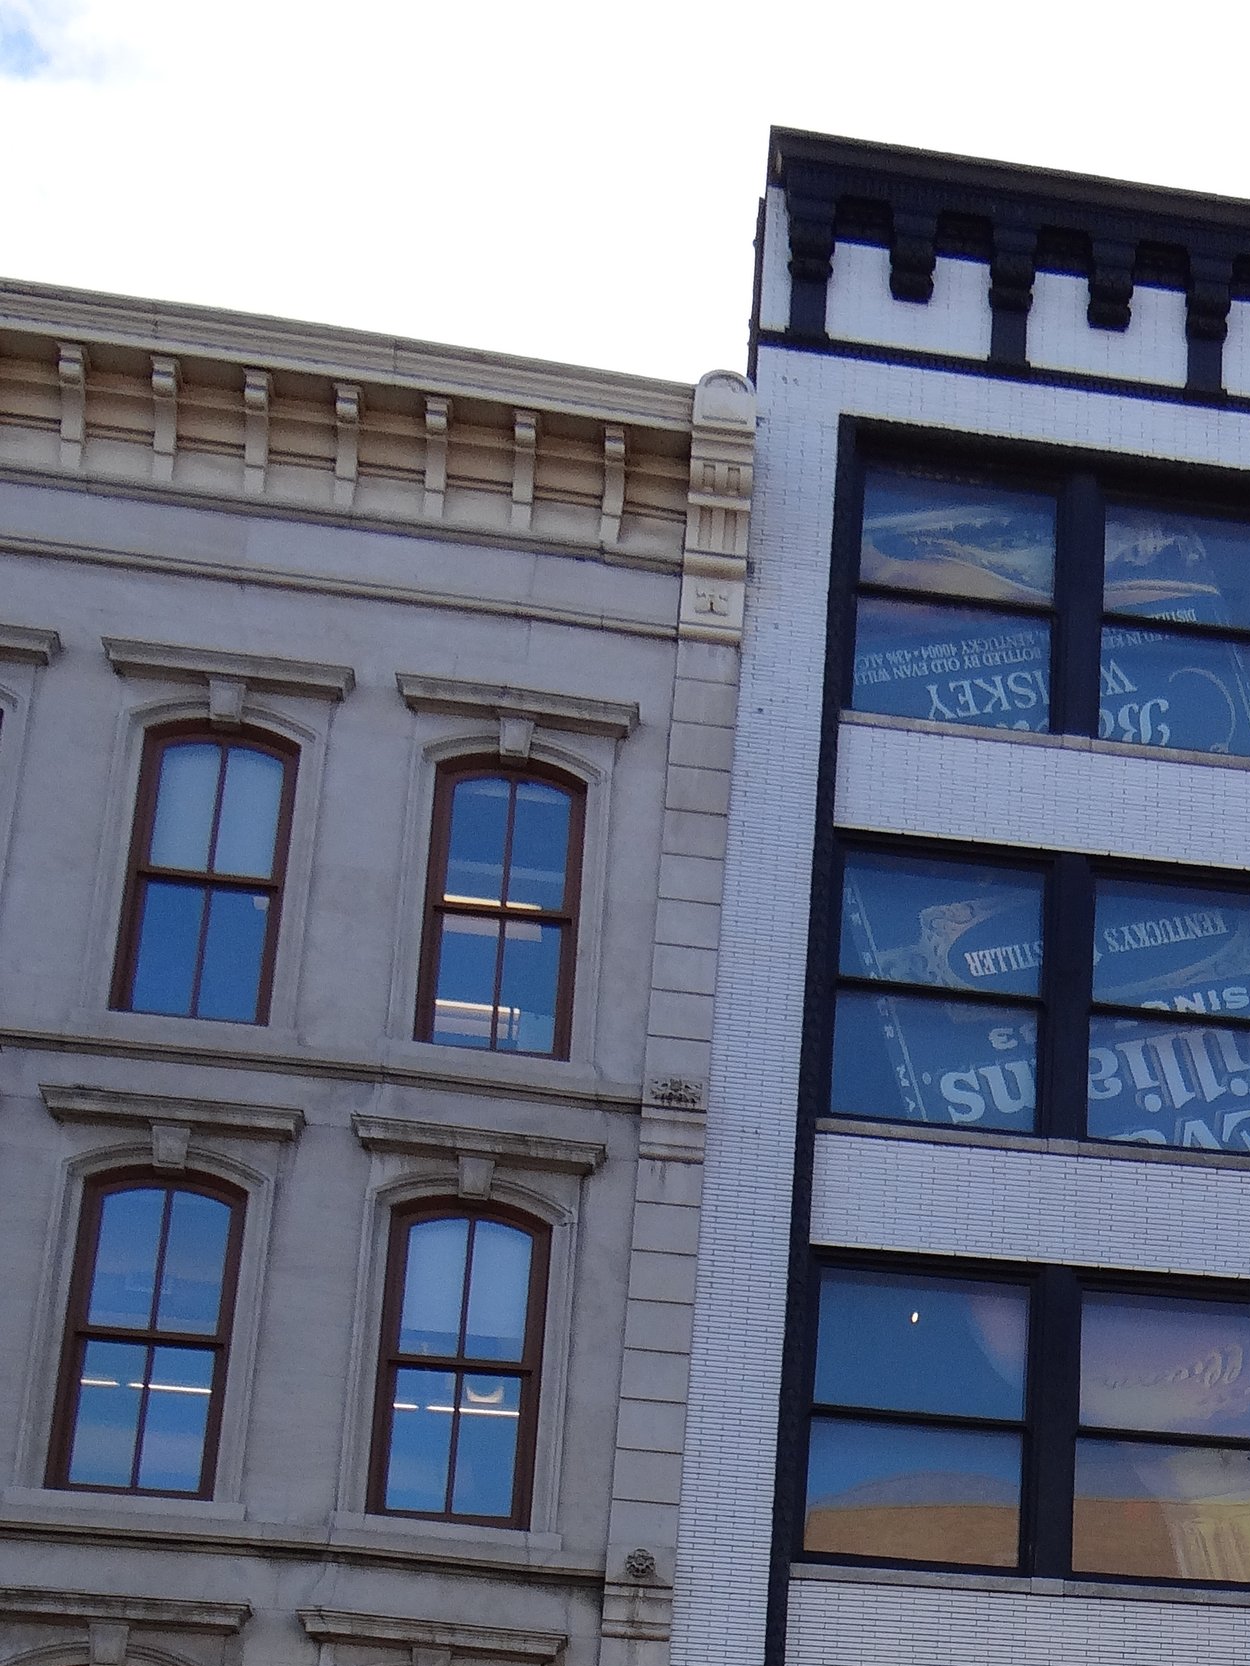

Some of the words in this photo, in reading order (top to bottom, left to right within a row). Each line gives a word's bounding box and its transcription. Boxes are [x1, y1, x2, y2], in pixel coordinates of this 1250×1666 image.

[893, 662, 927, 680] EVAN
[931, 658, 960, 674] OLD
[964, 656, 980, 669] BY
[1103, 910, 1229, 953] KENTUCKY'S
[964, 942, 1041, 977] TILLER
